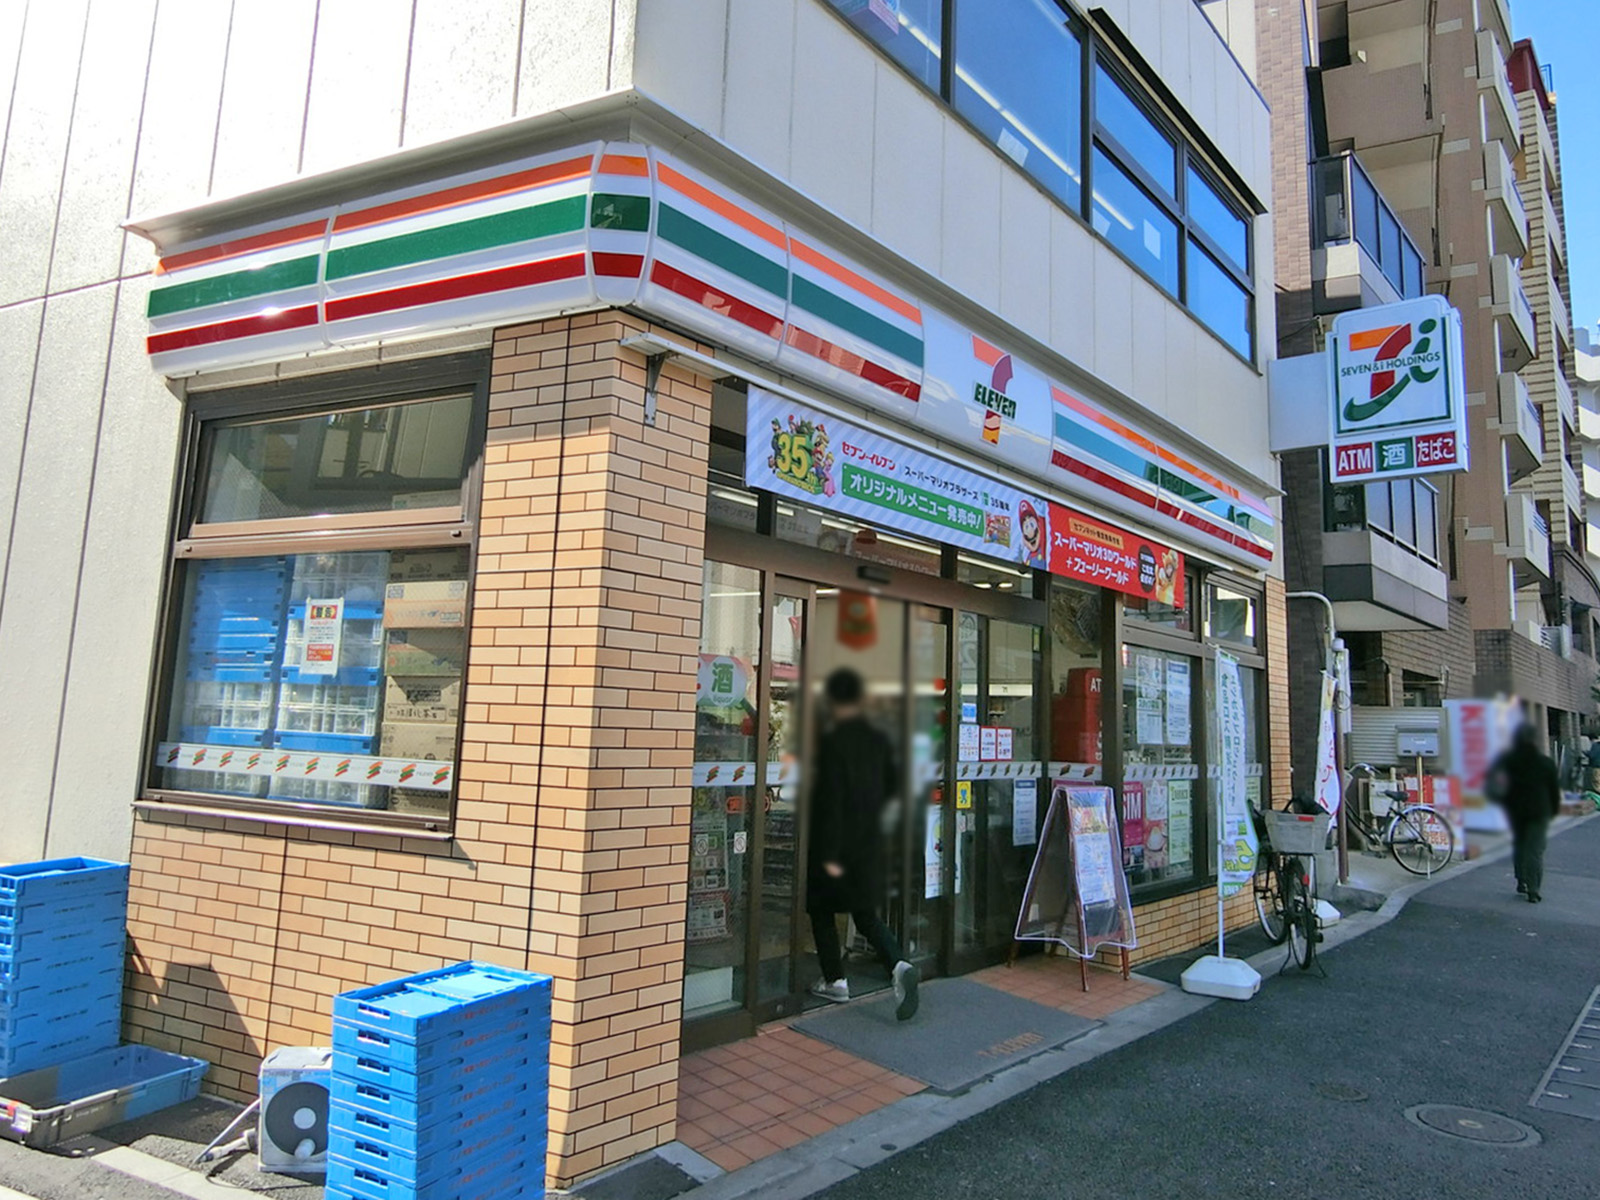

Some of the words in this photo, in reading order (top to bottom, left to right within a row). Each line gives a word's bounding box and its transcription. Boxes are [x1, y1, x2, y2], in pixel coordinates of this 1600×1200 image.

[1341, 363, 1372, 377] SEVEN
[1372, 361, 1380, 372] &
[1386, 351, 1441, 369] HOLDINGS
[1338, 447, 1371, 471] ATM
[1382, 442, 1406, 467] 酒
[1417, 437, 1455, 462] たばこ
[1054, 532, 1138, 571] スーパーマリオ3Dワールド
[711, 662, 734, 693] 酒
[1090, 677, 1102, 692] AT
